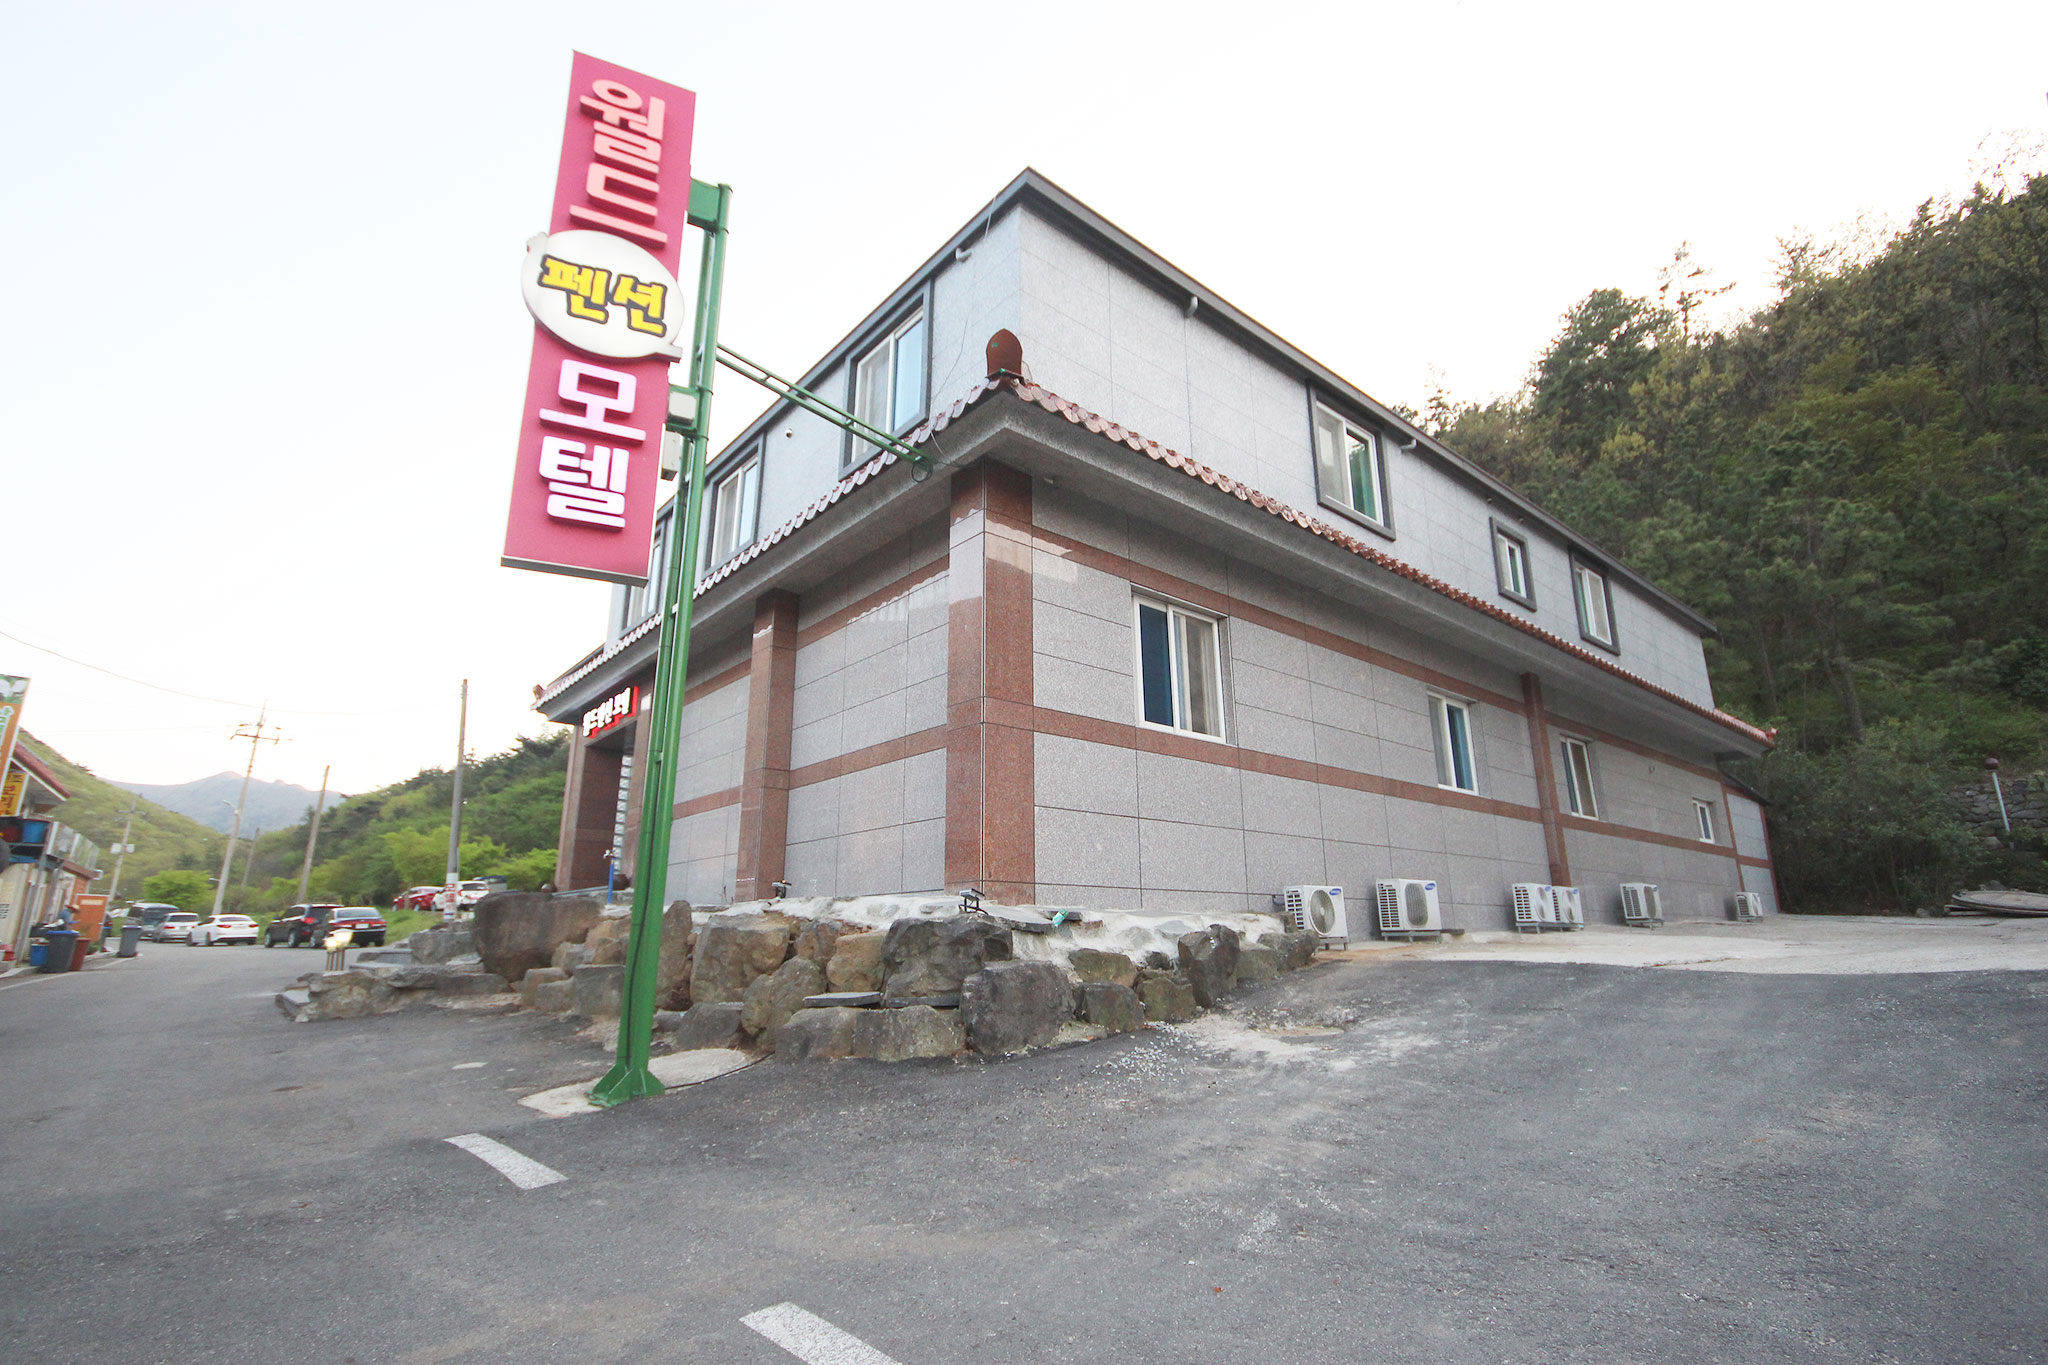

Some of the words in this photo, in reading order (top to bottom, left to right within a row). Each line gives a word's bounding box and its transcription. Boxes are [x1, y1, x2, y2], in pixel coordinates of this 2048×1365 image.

[568, 78, 668, 248] 월드
[538, 254, 668, 338] 펜션
[538, 358, 647, 529] 모텔
